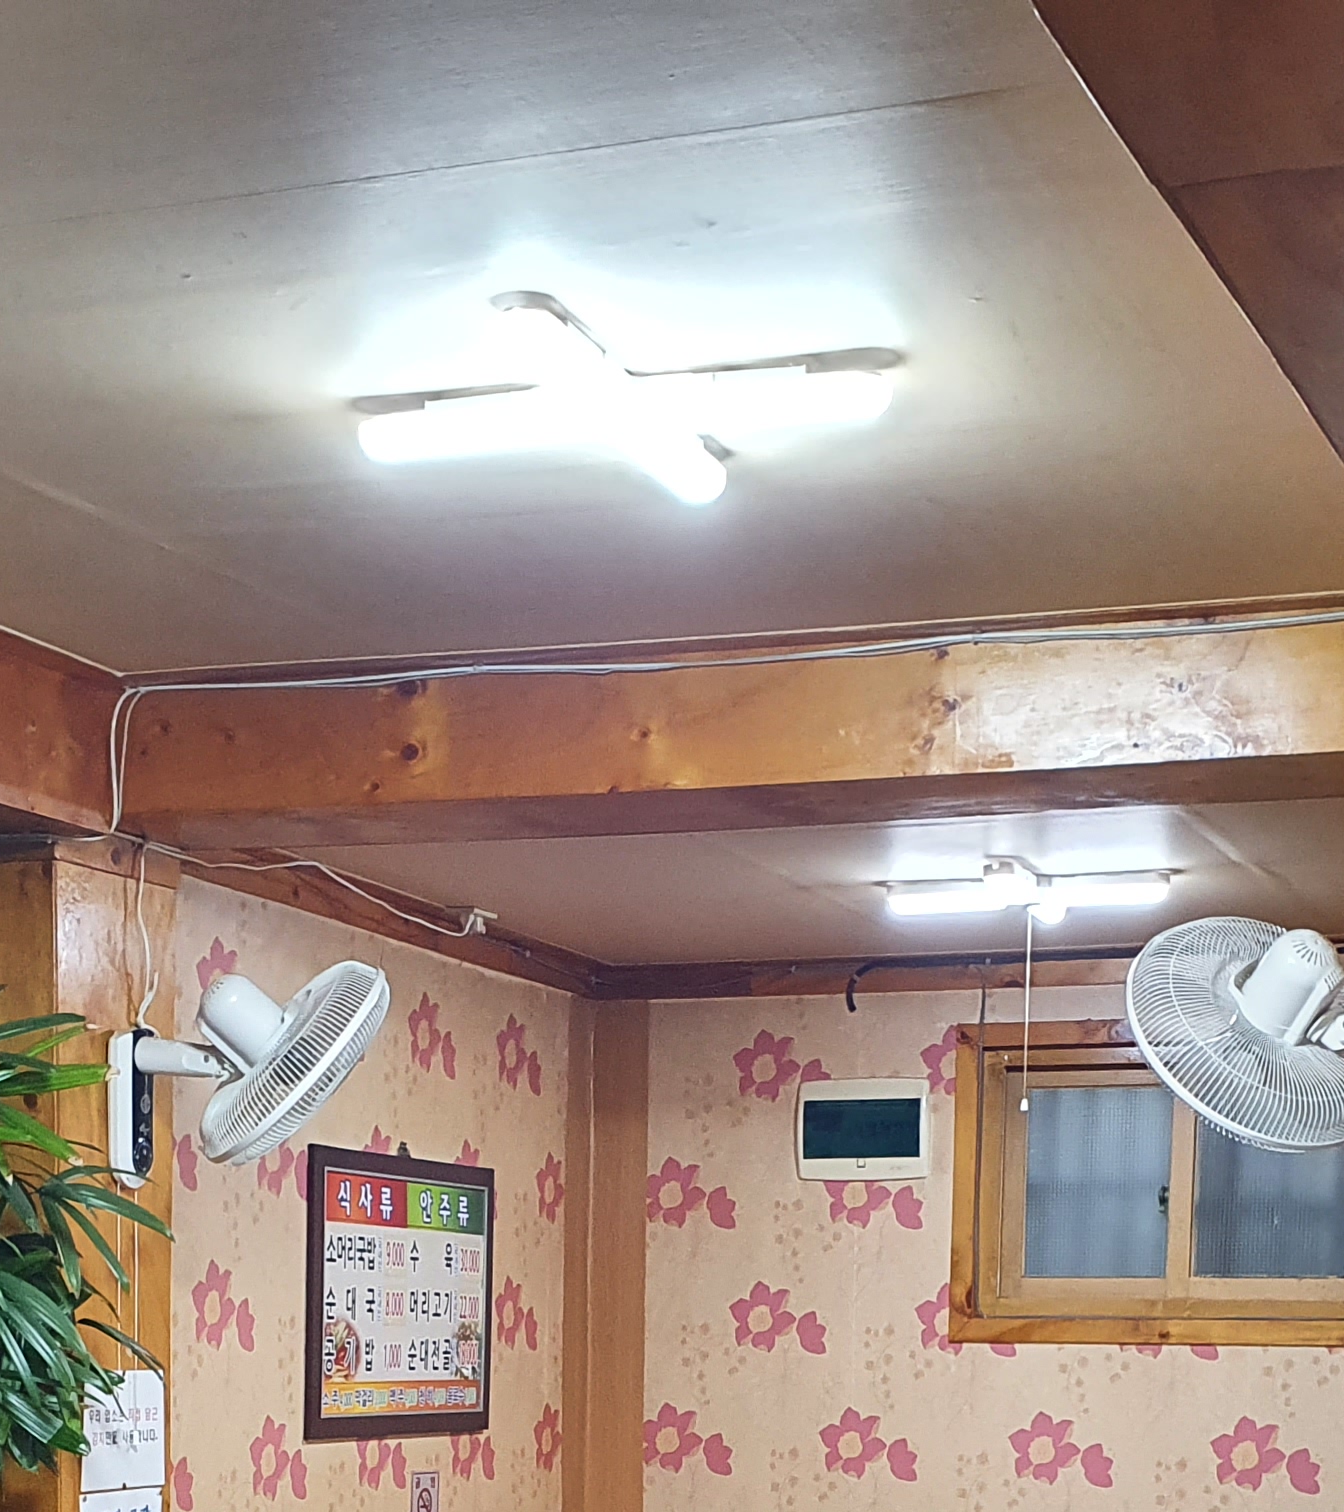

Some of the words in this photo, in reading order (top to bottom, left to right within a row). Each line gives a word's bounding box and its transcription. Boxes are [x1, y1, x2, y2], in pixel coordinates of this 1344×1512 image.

[325, 1234, 377, 1271] 소머리국밥
[409, 1288, 453, 1323] 머리고기
[407, 1338, 452, 1372] 순대전골
